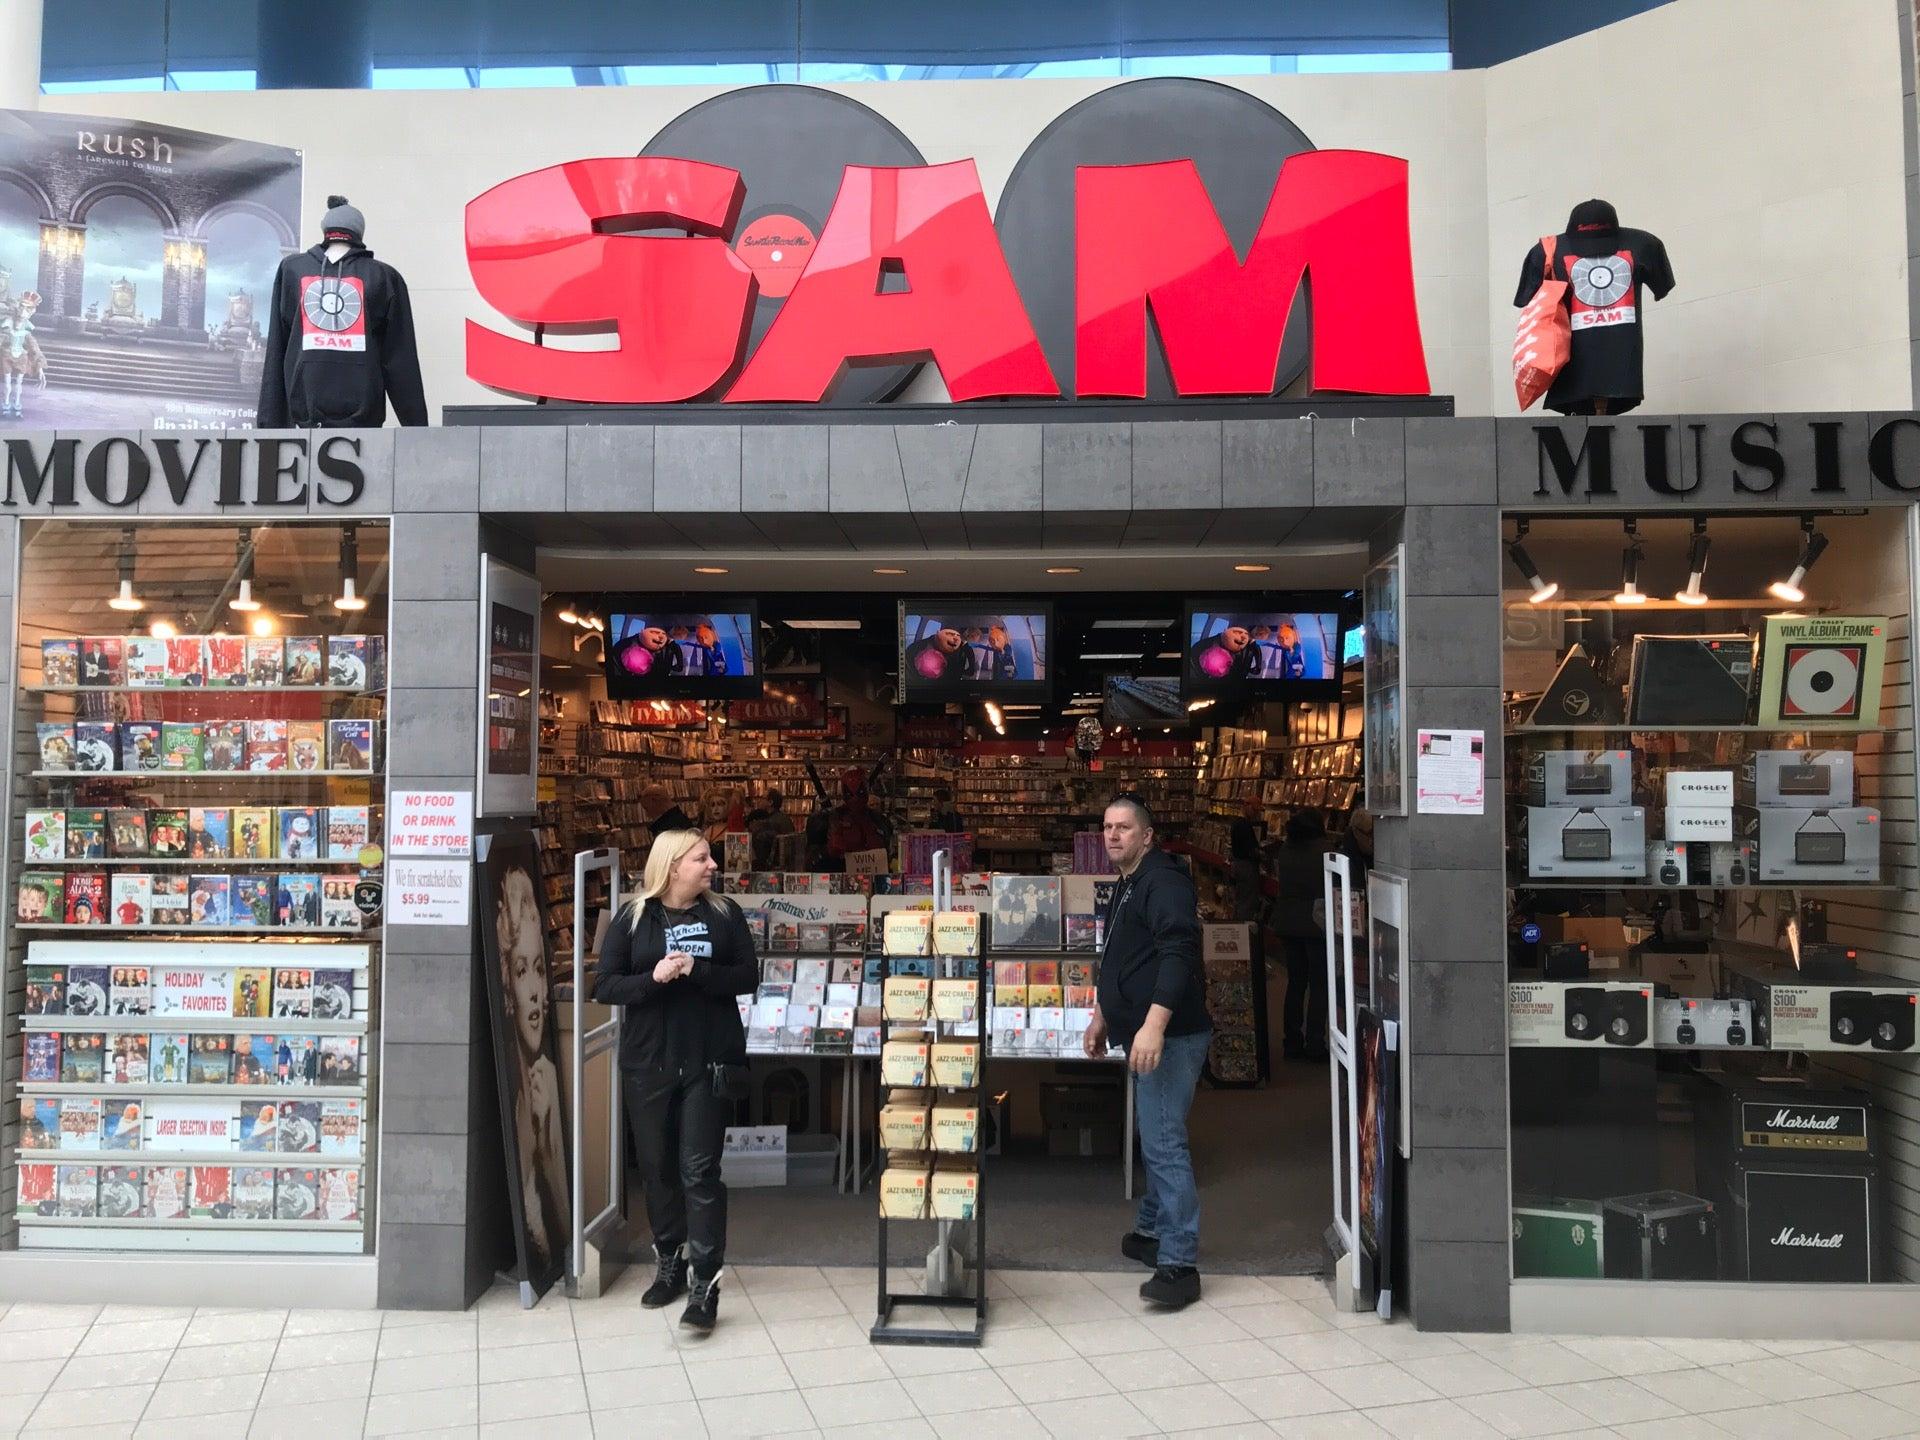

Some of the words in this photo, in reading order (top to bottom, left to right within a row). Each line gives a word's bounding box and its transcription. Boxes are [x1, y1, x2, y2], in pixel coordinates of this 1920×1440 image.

[465, 149, 1430, 404] SAM
[1583, 311, 1622, 325] SAM
[313, 336, 353, 348] SAM
[1531, 419, 1920, 496] MUSIC
[3, 438, 366, 508] MOVIES
[1781, 625, 1806, 637] VINYL
[1809, 625, 1840, 637] ALBUM
[1843, 625, 1875, 637] FRAME
[405, 796, 421, 806] NO
[425, 796, 454, 806] FOOD
[403, 816, 418, 826] OR
[421, 816, 456, 826] DRINK
[392, 835, 404, 846] IN
[408, 835, 429, 846] THE
[432, 836, 469, 846] STORE
[855, 855, 875, 864] WIN
[402, 893, 430, 905] $5.99
[762, 897, 805, 920] Christmas
[805, 906, 828, 921] Sale
[1525, 929, 1537, 937] ADT
[165, 972, 204, 988] HOLIDAY
[1511, 991, 1532, 1003] S100
[1774, 995, 1796, 1007] S100
[182, 996, 227, 1012] FAVORITES
[1766, 1109, 1840, 1130] Marshall
[156, 1119, 178, 1135] LARGER
[179, 1119, 207, 1135] SELECTION
[209, 1119, 227, 1135] INSIDE
[1770, 1227, 1844, 1248] Marshall
